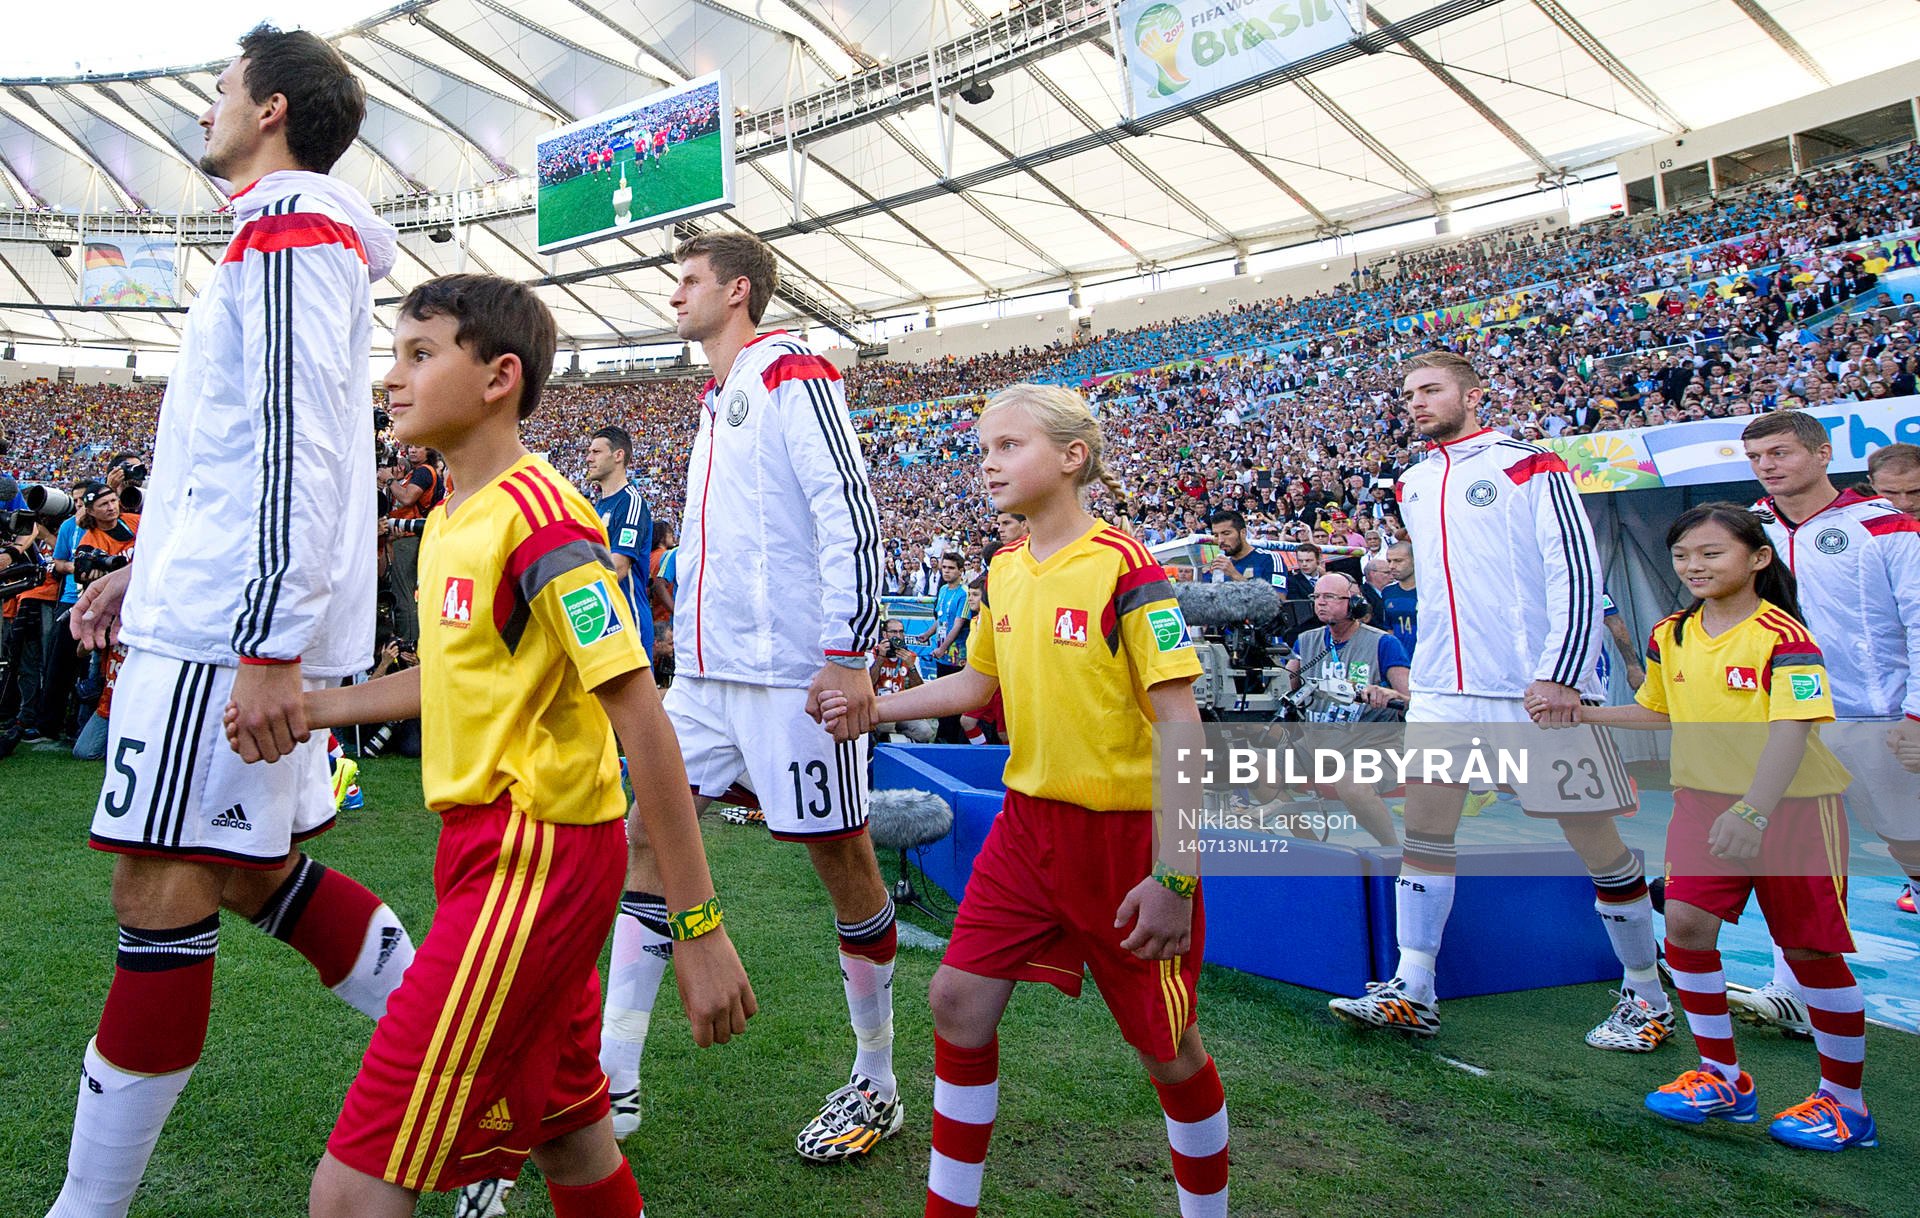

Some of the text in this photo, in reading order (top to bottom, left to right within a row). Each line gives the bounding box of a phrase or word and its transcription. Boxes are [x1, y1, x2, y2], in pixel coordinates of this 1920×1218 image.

[1192, 6, 1225, 27] FIFA
[1660, 159, 1672, 169] 03
[606, 624, 622, 634] FIFA
[1398, 616, 1412, 635] 14
[105, 737, 146, 818] 5
[1552, 757, 1605, 800] 23
[788, 760, 832, 820] 13
[211, 817, 252, 831] adidas
[479, 1118, 513, 1131] adidas
